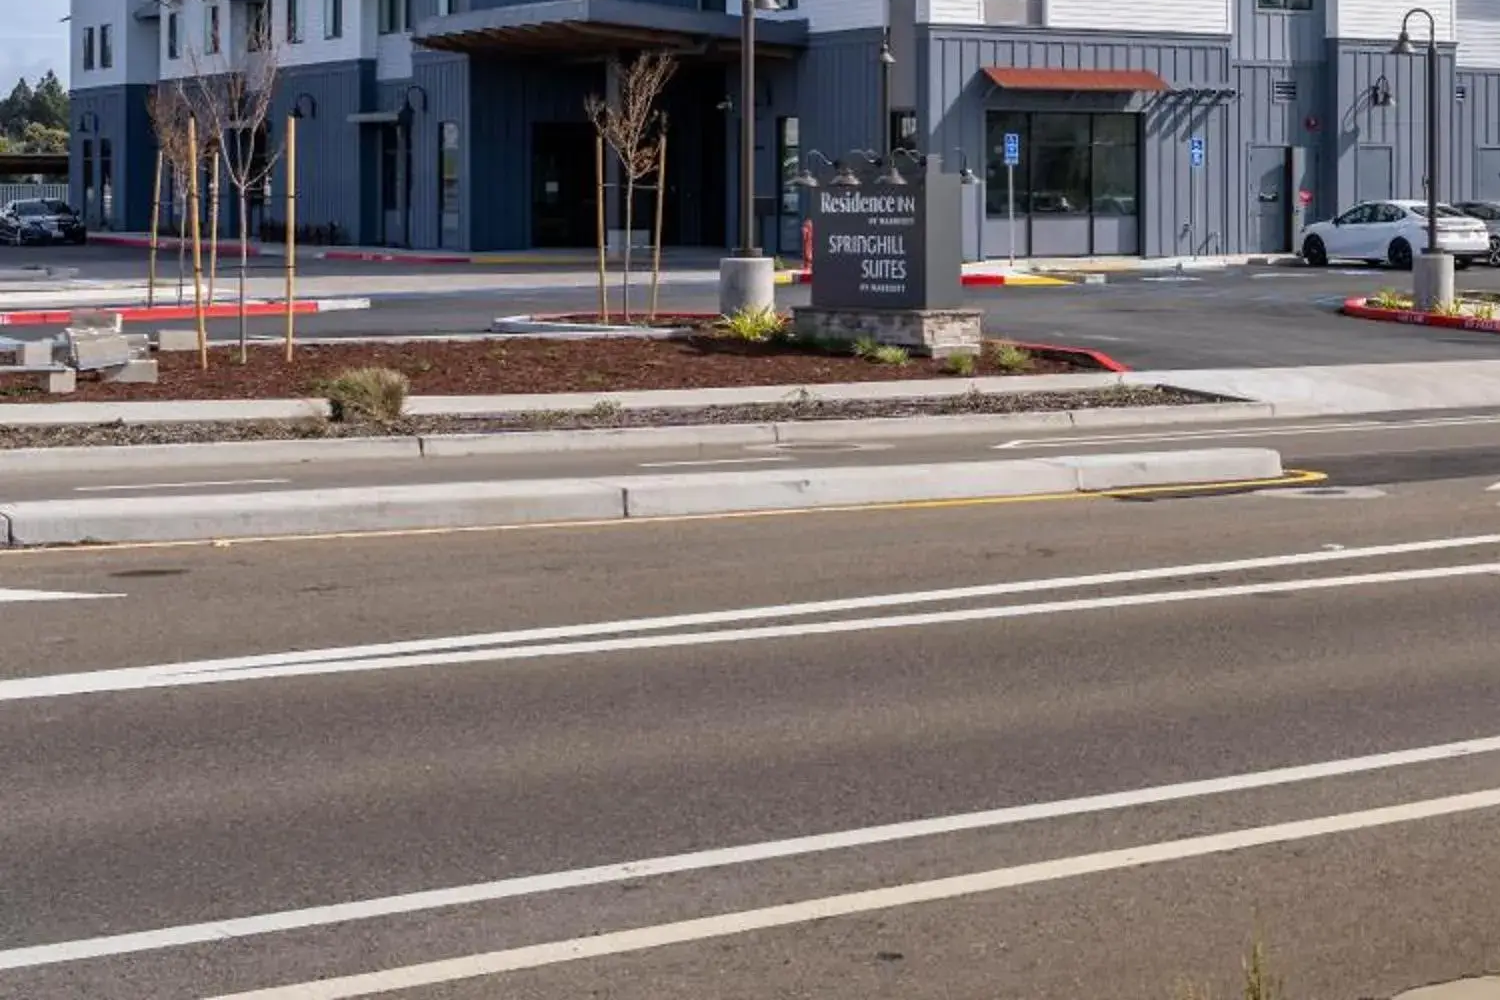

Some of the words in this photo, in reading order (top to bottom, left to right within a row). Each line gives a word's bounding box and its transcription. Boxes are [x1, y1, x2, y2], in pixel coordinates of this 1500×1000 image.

[821, 191, 895, 214] Residence
[828, 235, 906, 255] SPRINGHILL
[861, 259, 907, 279] SUITES
